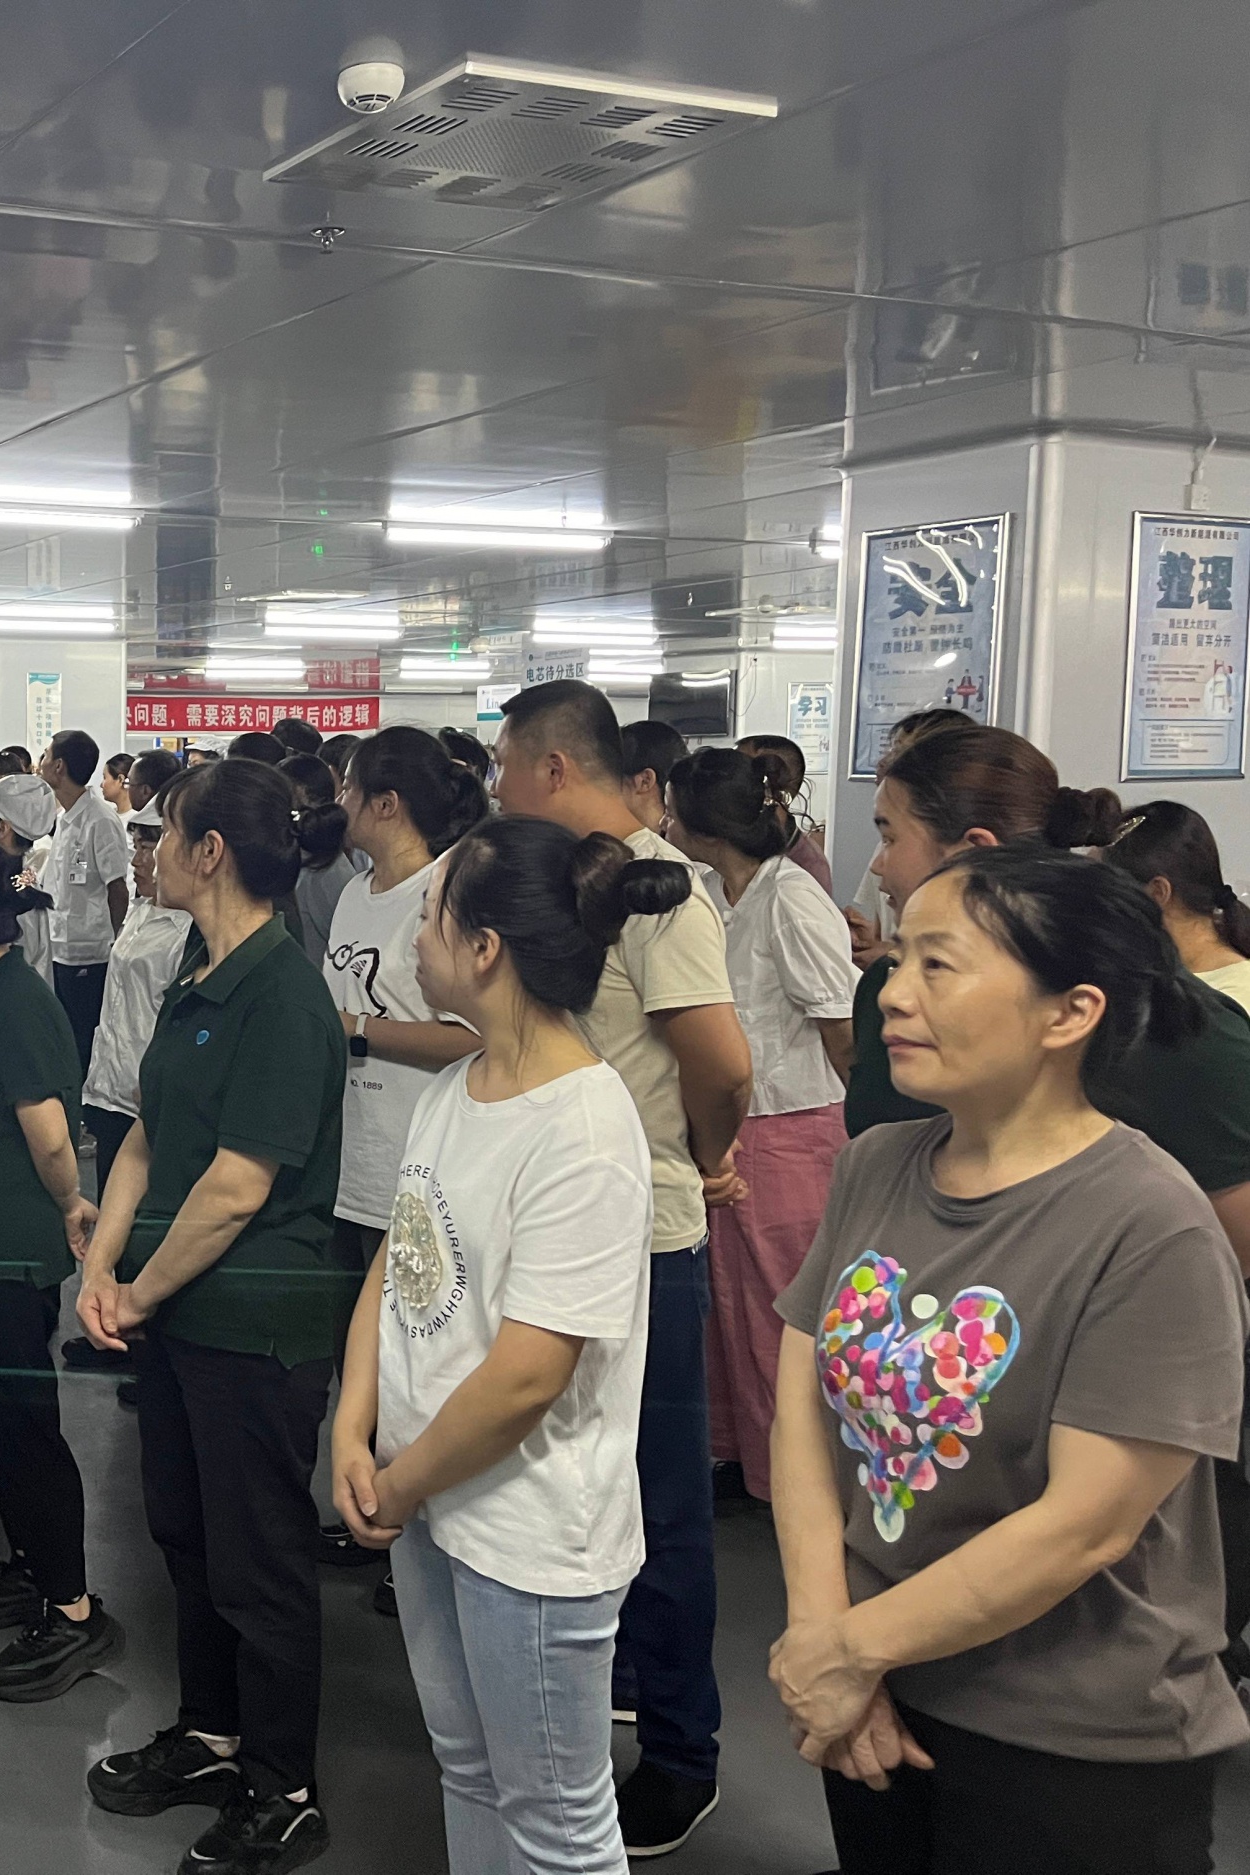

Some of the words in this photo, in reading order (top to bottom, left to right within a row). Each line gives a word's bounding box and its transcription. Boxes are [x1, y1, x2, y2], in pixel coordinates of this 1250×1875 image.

[888, 557, 977, 620] 安全
[1156, 550, 1233, 610] 整理
[526, 662, 585, 682] 电芯待分选区
[798, 695, 828, 717] 学习
[362, 1080, 383, 1091] 1889
